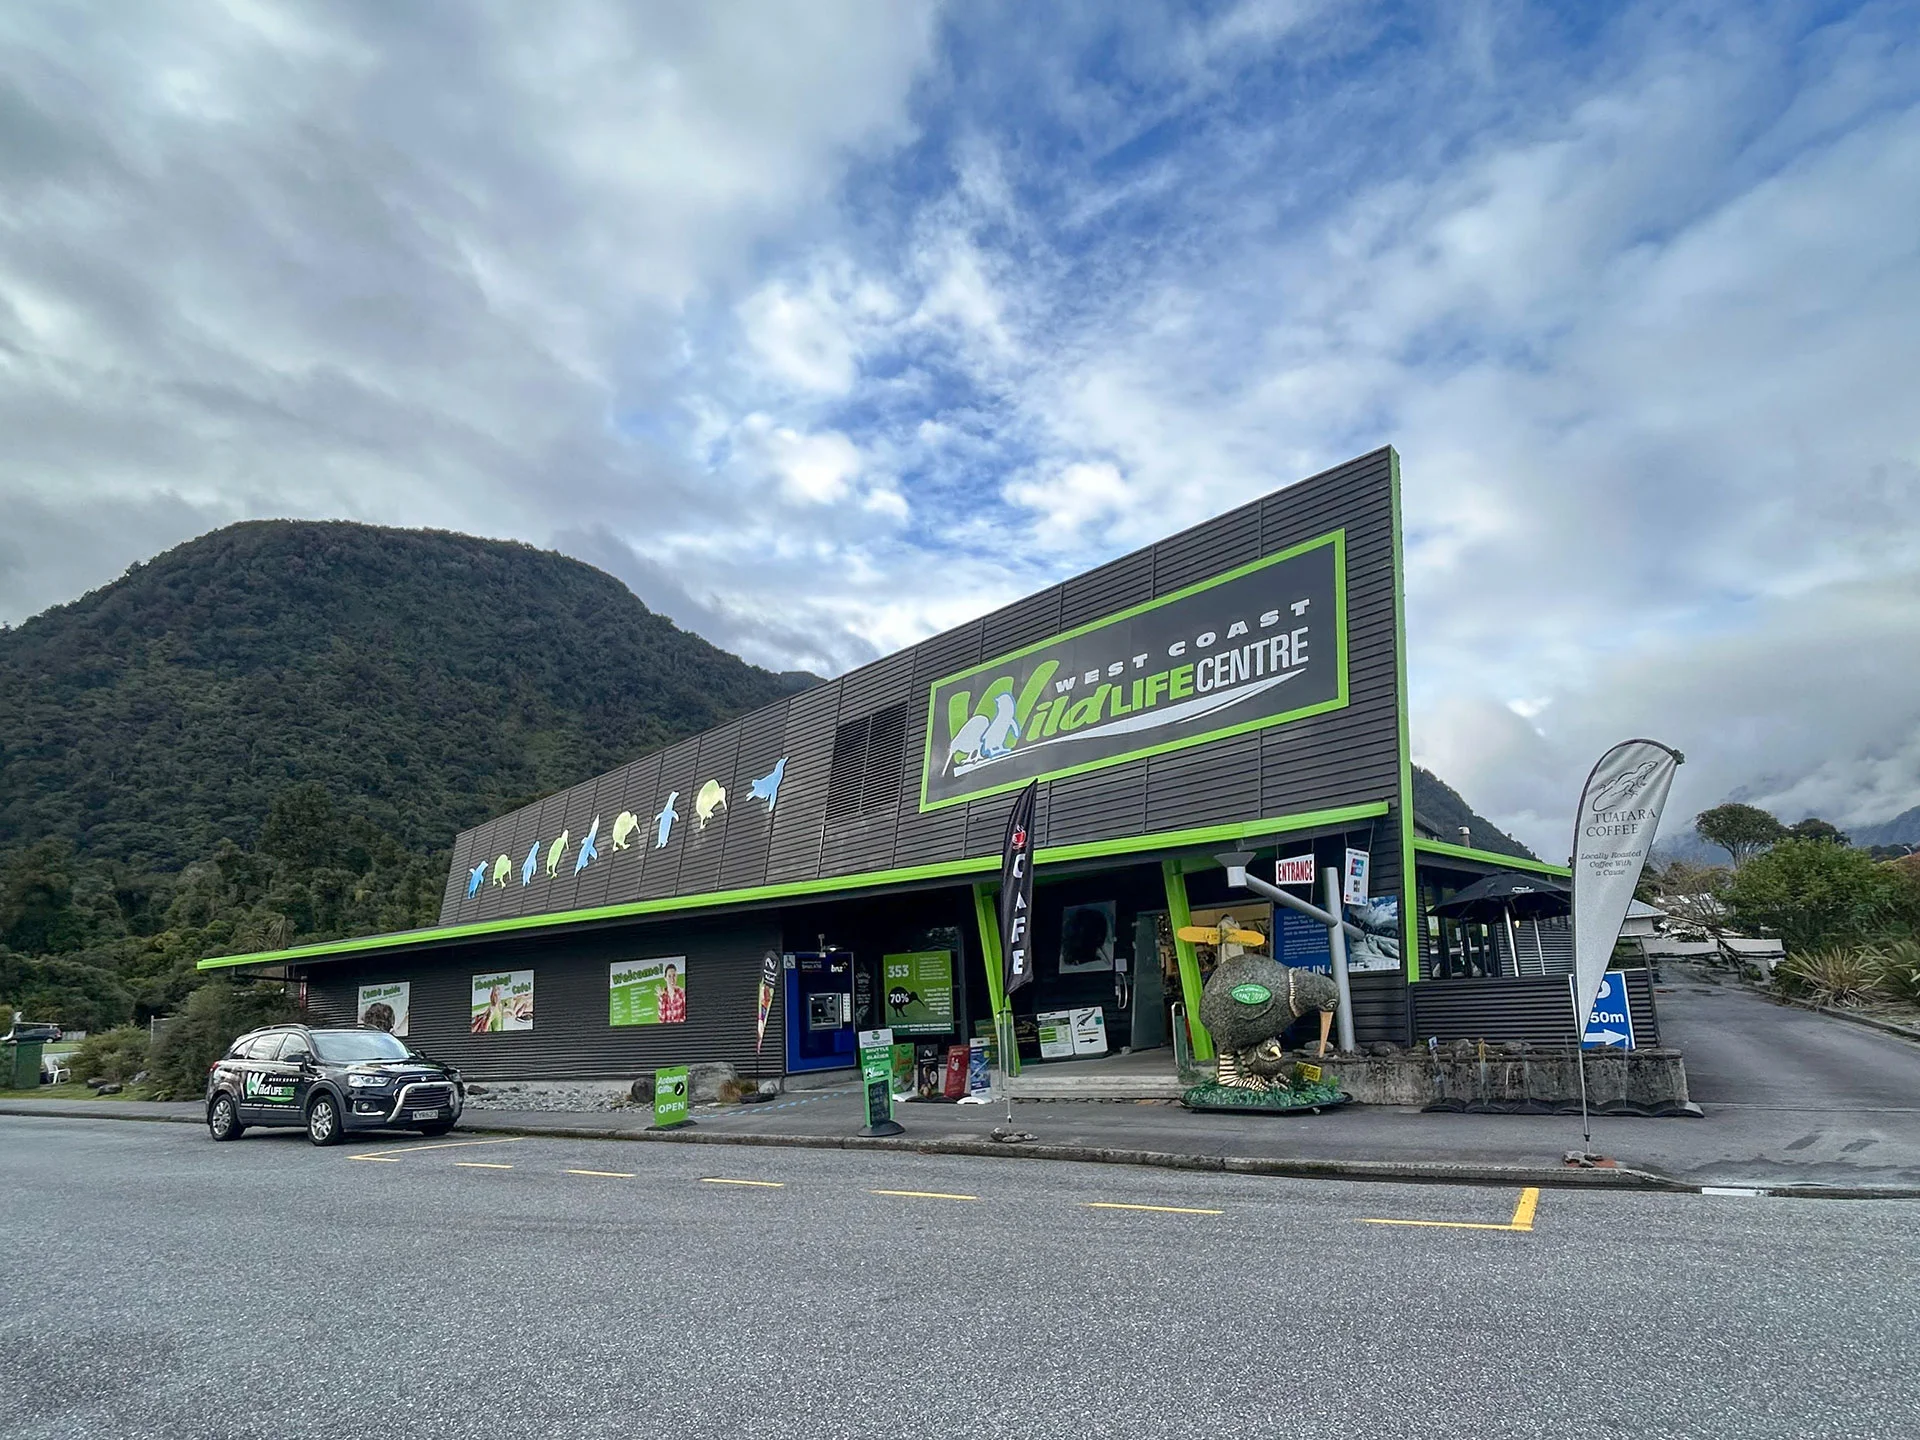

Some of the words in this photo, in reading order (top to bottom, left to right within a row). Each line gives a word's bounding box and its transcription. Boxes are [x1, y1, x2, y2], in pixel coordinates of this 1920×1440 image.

[1055, 653, 1148, 693] WEST
[1168, 598, 1310, 657] COAST
[1593, 808, 1657, 823] TUATARA
[1586, 823, 1639, 838] COFFEE
[1580, 851, 1609, 862] Locally
[1611, 850, 1643, 860] Roasted
[1278, 859, 1313, 882] ENTRANCE
[1589, 861, 1613, 871] Coffee
[1615, 859, 1633, 869] With
[1603, 869, 1626, 877] Cause
[1011, 853, 1028, 976] CAFE
[612, 963, 664, 985] Welcome!
[830, 963, 843, 973] bnz
[888, 964, 909, 978] 353
[1312, 964, 1326, 975] IN
[889, 993, 910, 1004] 70%
[1589, 1011, 1625, 1024] 50m
[658, 1101, 685, 1114] OPEN
